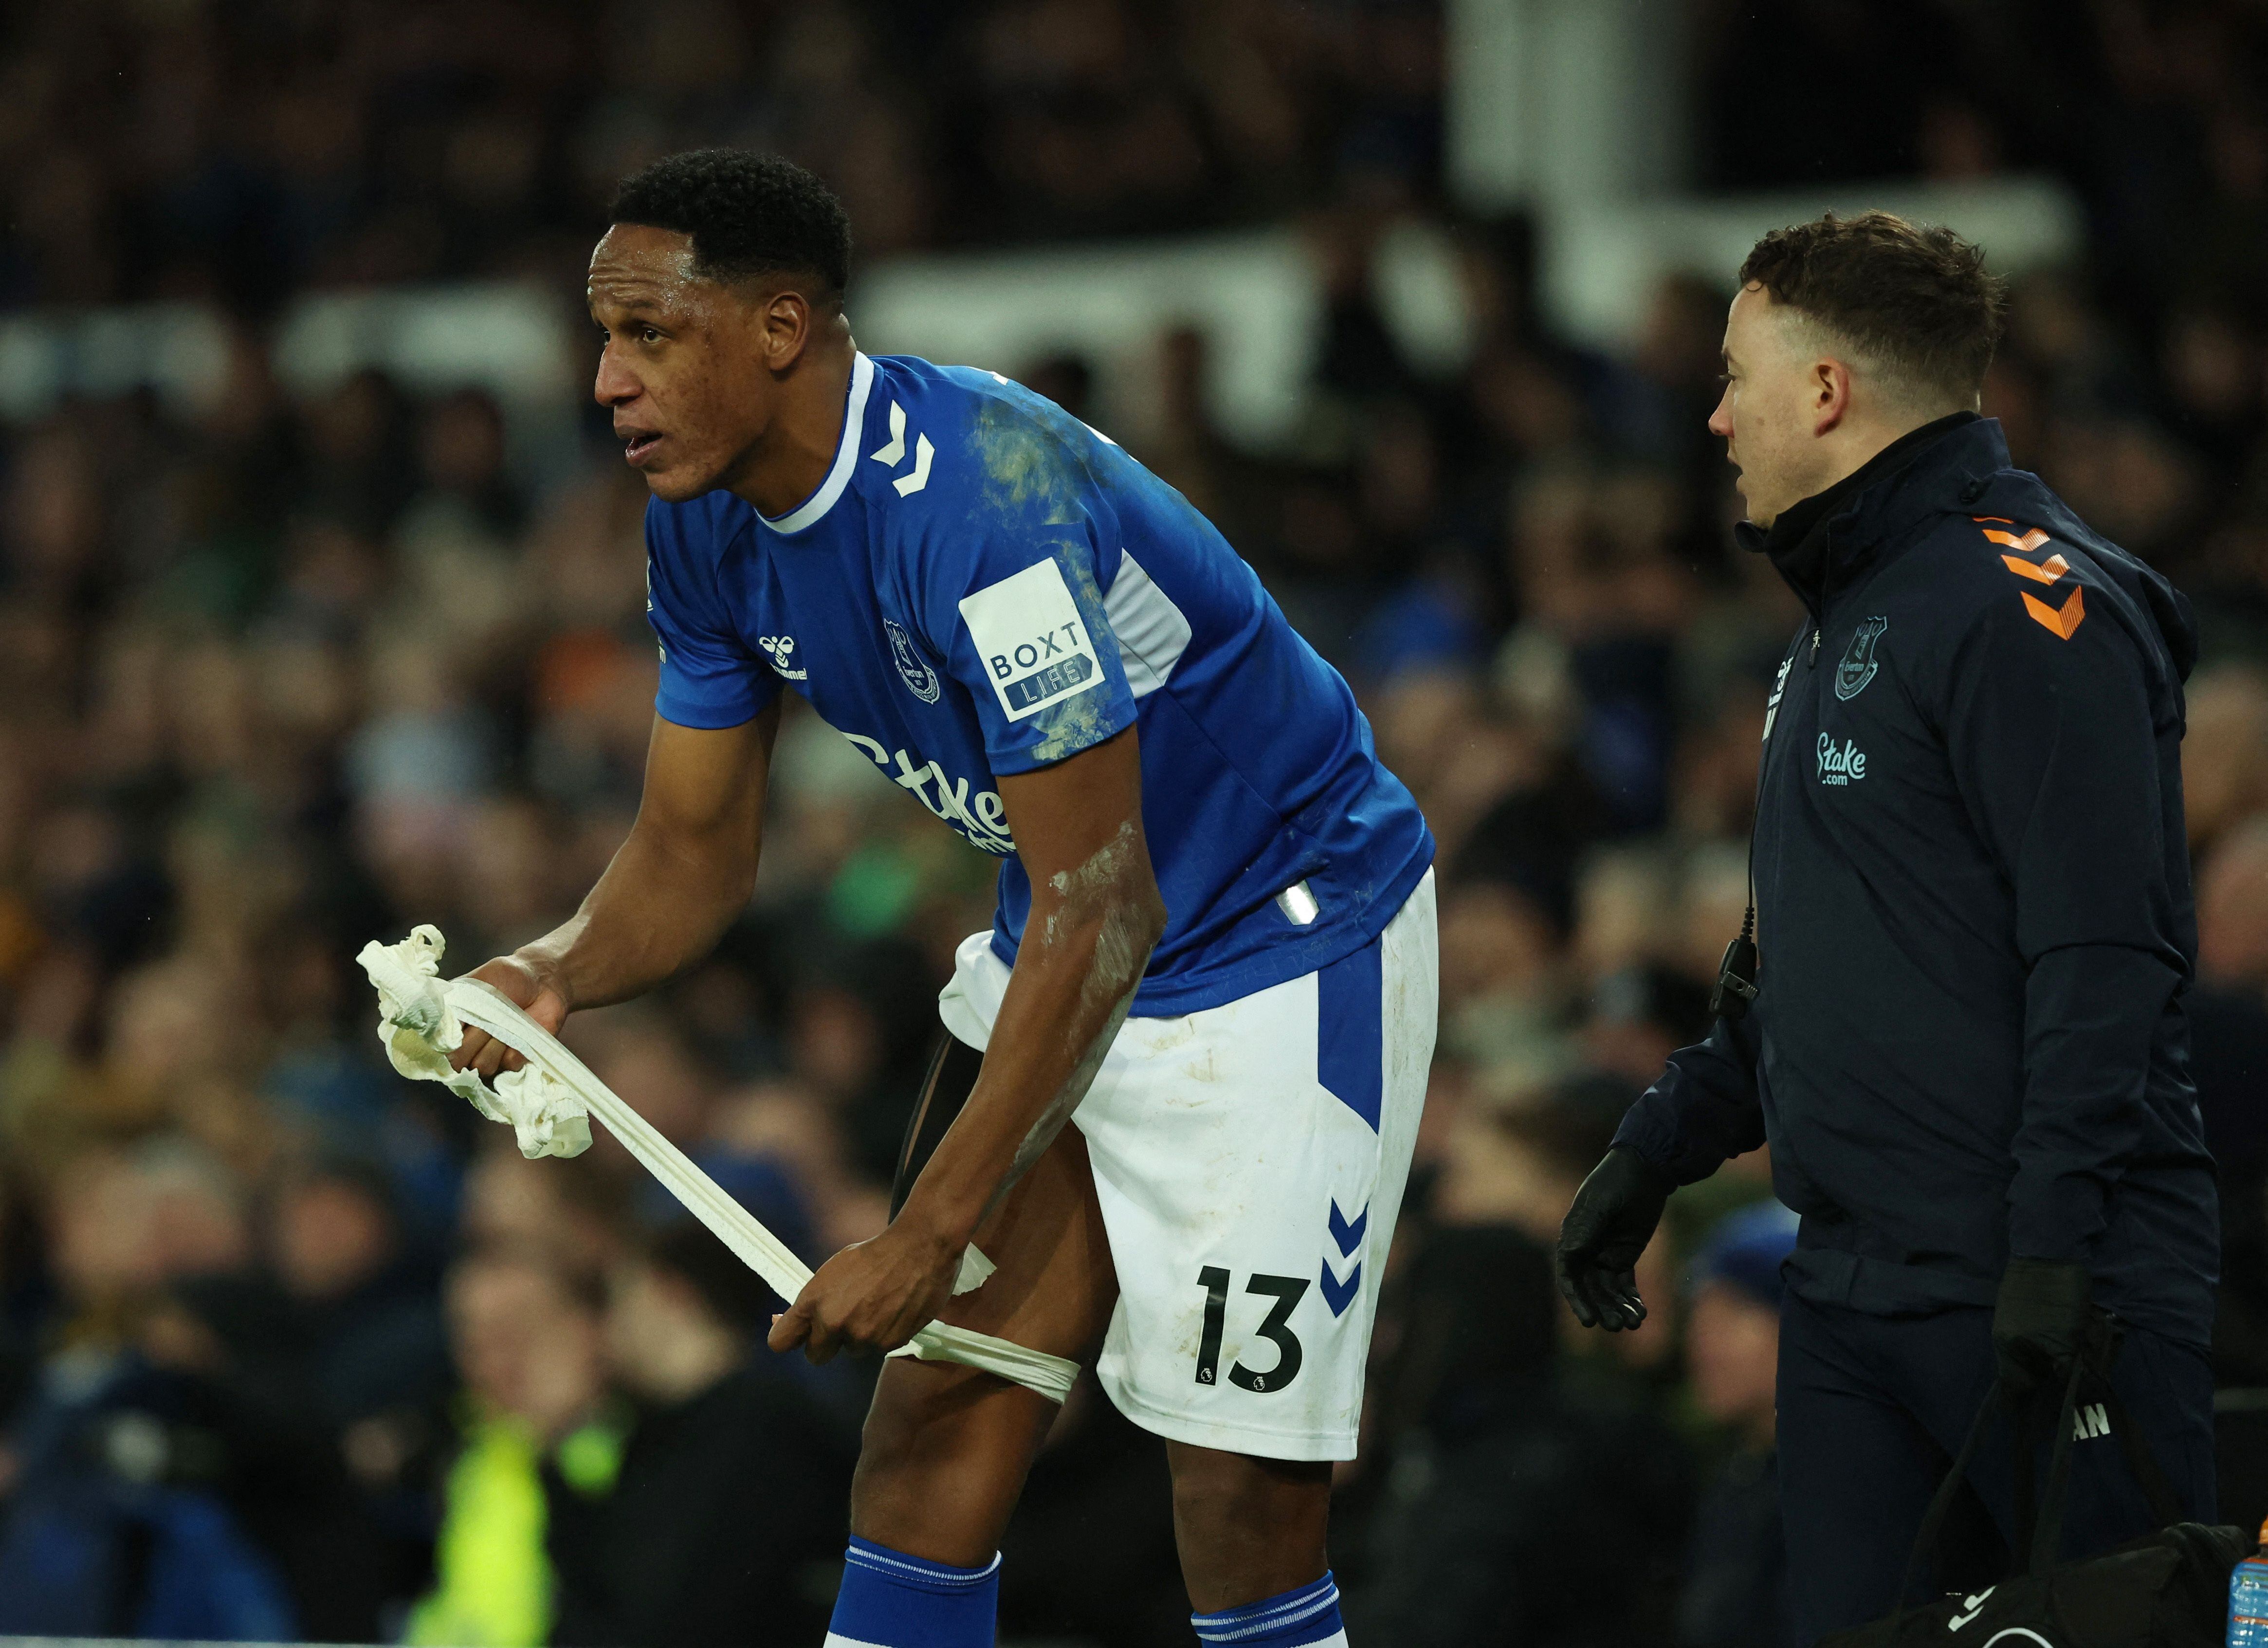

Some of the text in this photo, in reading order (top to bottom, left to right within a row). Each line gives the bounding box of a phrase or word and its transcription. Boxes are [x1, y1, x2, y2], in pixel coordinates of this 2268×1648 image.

[990, 621, 1079, 680] BOXT
[1020, 660, 1081, 702] LIFE
[1817, 732, 1866, 780] Stake
[1822, 774, 1848, 786] .com
[1195, 1265, 1311, 1393] 13
